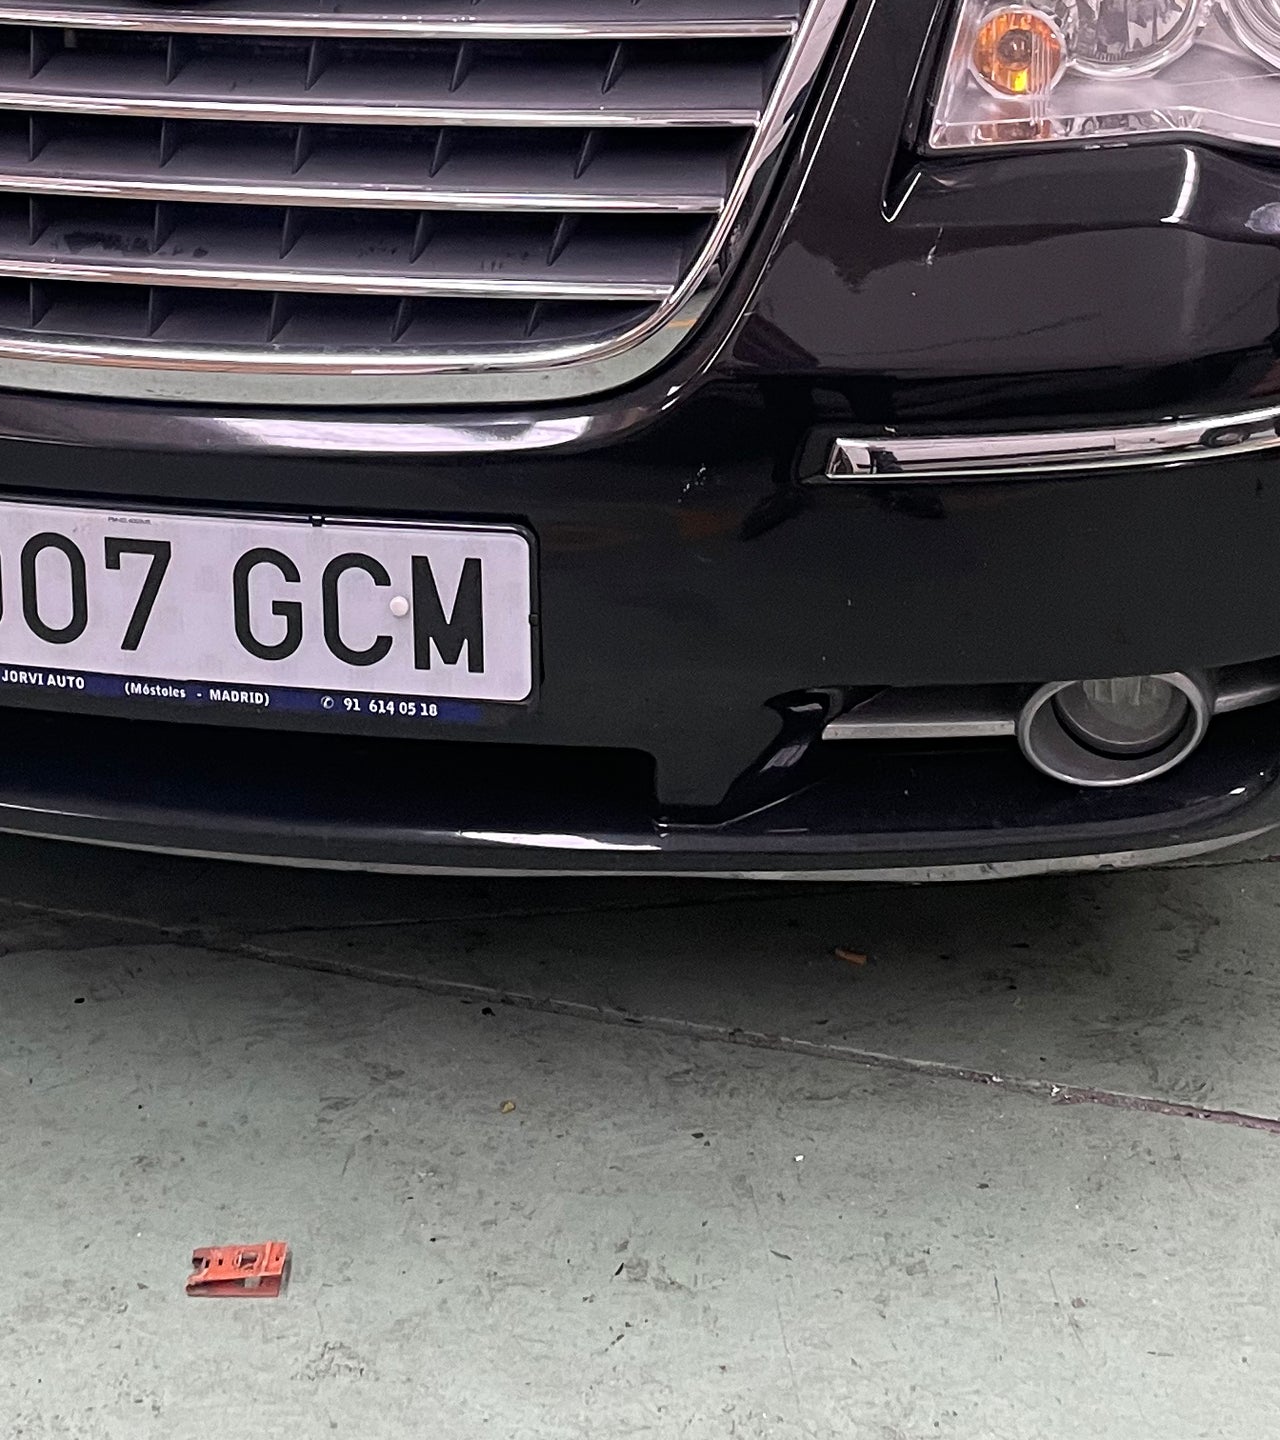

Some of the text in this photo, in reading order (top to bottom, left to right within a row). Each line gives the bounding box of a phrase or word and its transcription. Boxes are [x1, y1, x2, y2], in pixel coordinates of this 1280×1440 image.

[233, 547, 484, 673] GCM
[2, 670, 44, 686] JORVI
[47, 675, 86, 690] AUTO
[124, 682, 186, 699] (Móstoles
[209, 689, 271, 707] MADRID)
[343, 697, 361, 711] 91
[369, 699, 395, 715] 614
[399, 701, 416, 716] 05
[420, 703, 438, 717] 18
